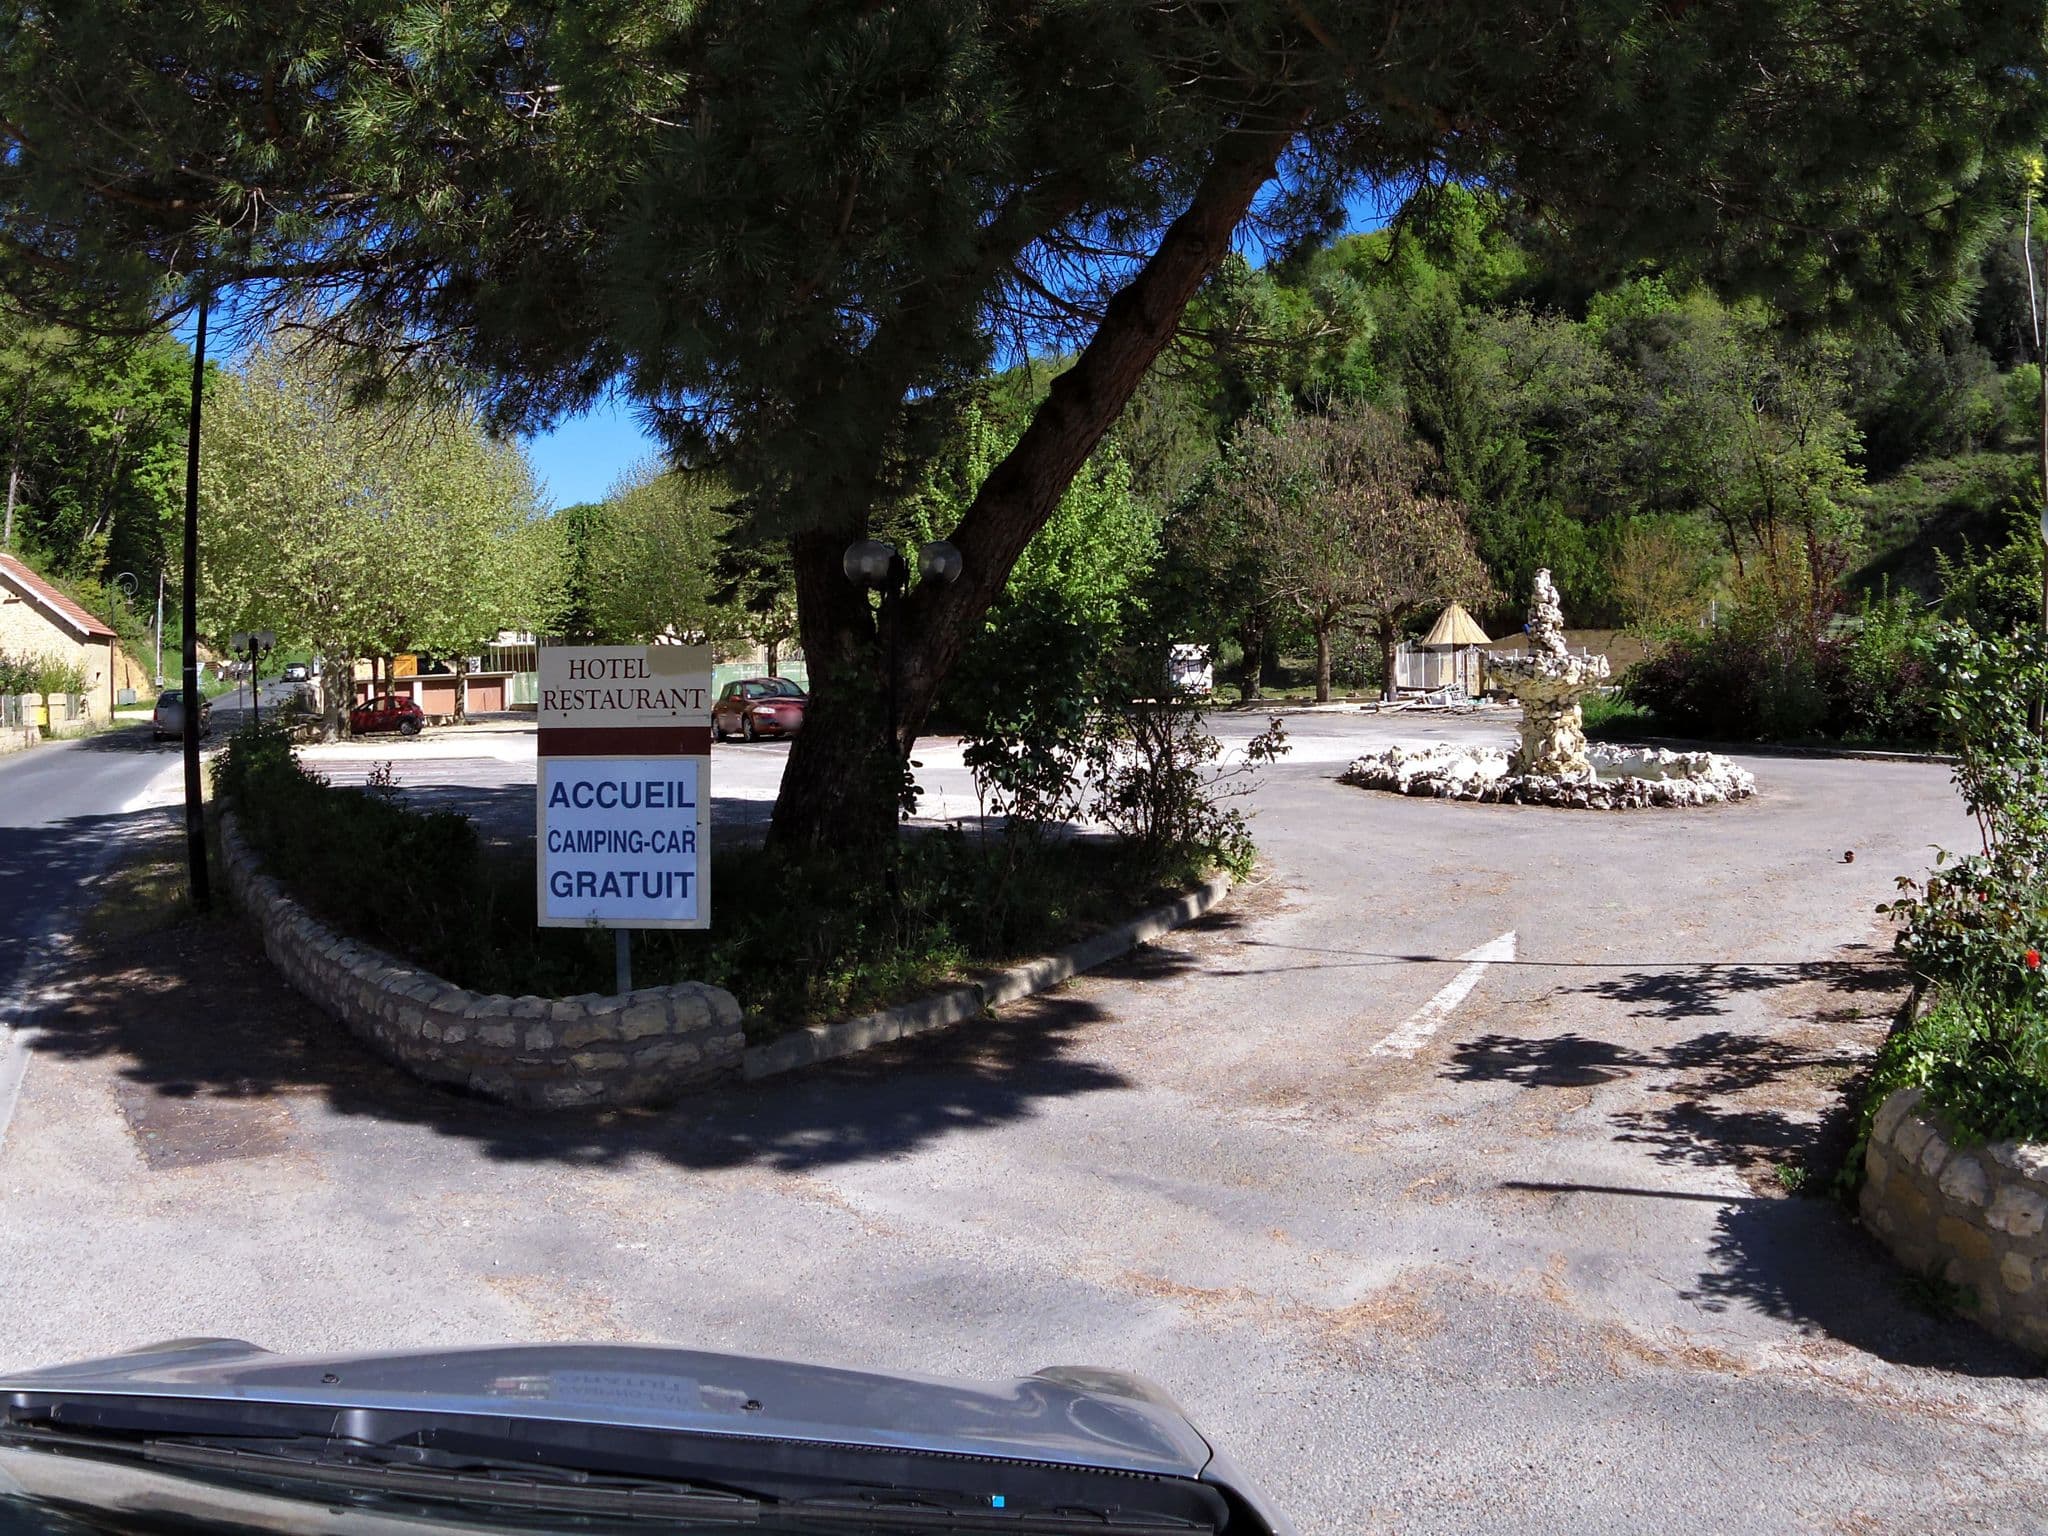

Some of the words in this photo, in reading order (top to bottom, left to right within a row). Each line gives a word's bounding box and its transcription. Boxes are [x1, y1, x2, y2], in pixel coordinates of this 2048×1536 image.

[568, 658, 651, 680] HOTEL
[543, 688, 706, 711] RESTAURANT
[548, 781, 696, 809] ACCUEIL
[548, 829, 696, 854] CAMPING-CAR
[550, 871, 695, 898] GRATUIT
